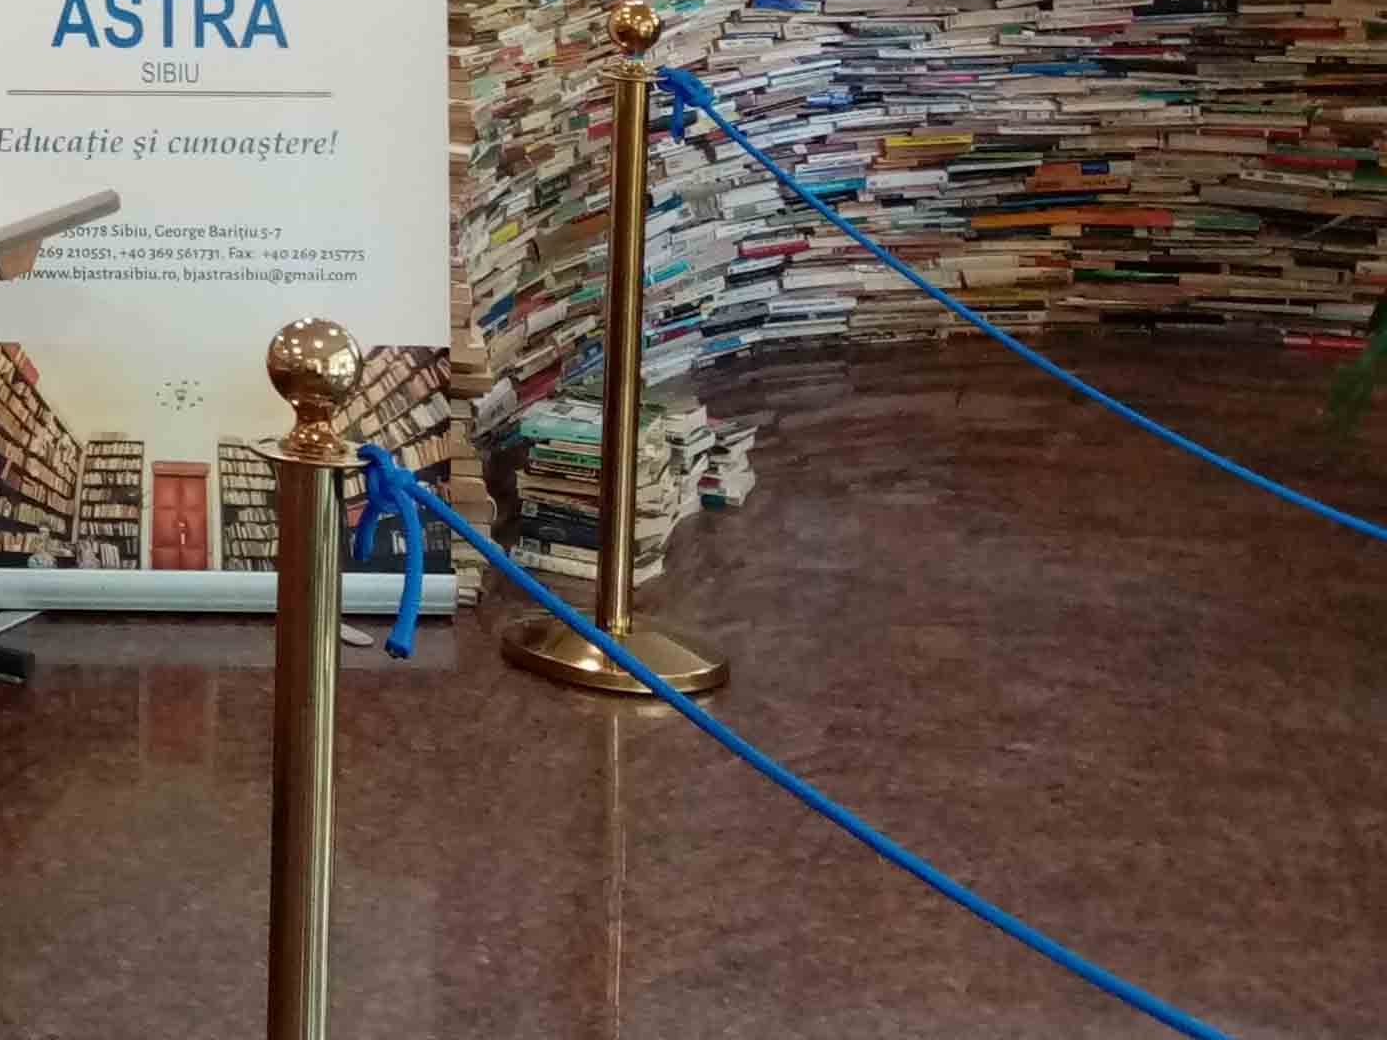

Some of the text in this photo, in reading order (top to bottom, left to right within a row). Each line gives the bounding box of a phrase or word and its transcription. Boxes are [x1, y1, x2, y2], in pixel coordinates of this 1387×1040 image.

[141, 62, 200, 84] SIBIU
[110, 224, 152, 239] Sibiu,
[155, 225, 205, 240] George
[261, 226, 282, 240] 5-7
[149, 247, 174, 260] 369
[263, 248, 288, 261] +40
[292, 247, 317, 261] 269
[320, 248, 366, 262] 215775
[182, 266, 358, 284] bjastrasibiu@gmail.com
